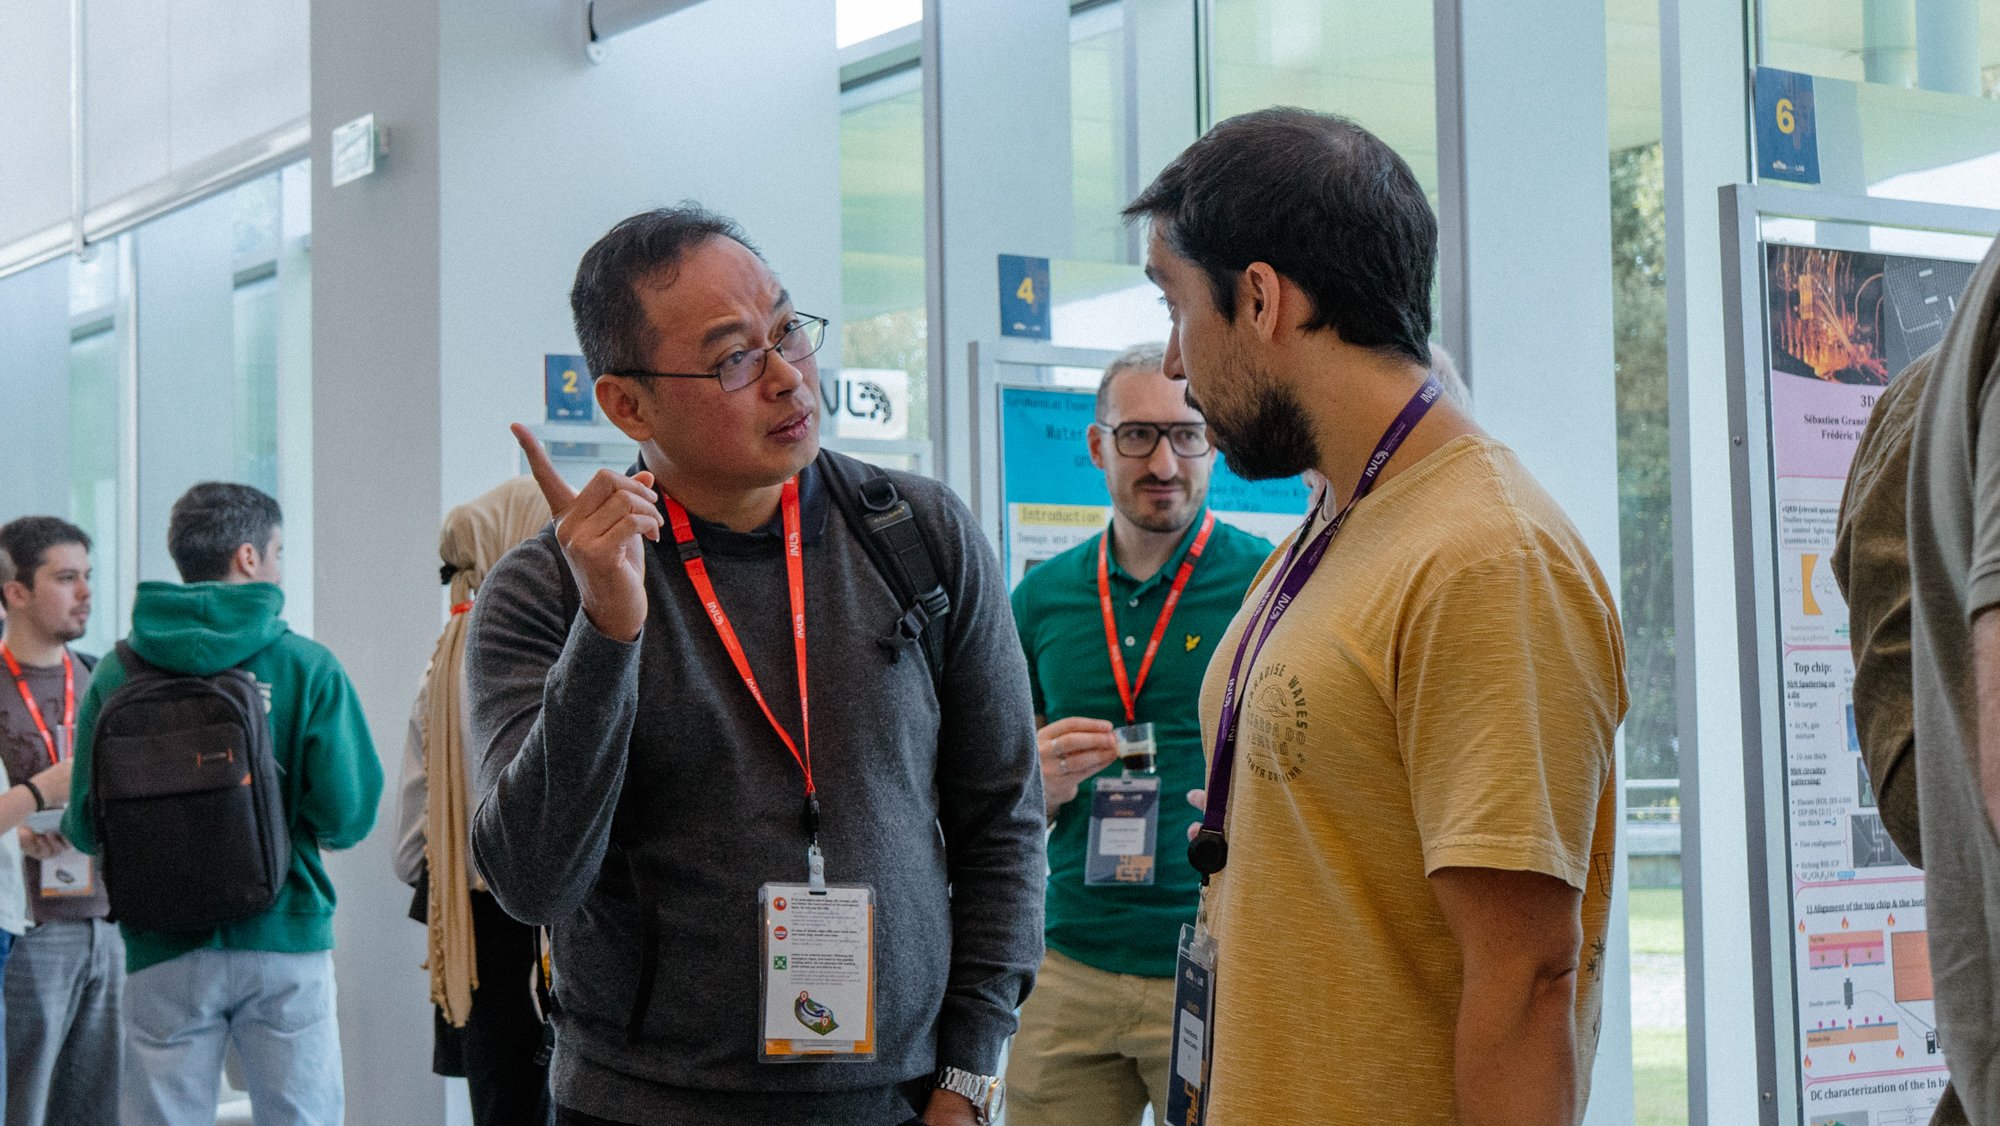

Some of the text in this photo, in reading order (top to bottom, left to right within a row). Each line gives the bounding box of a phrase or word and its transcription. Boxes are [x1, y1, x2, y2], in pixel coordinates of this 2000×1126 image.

[1776, 98, 1795, 134] 6
[1016, 277, 1035, 304] 4
[562, 370, 577, 394] 2
[1860, 395, 1875, 407] 3D
[1804, 413, 1869, 427] Sébastien Granel
[1821, 429, 1853, 441] Frédéric
[707, 602, 722, 624] INL
[1794, 662, 1832, 675] Top chip:
[1287, 675, 1308, 730] WAVES
[1814, 904, 1845, 914] Alignment
[1864, 902, 1875, 911] top
[1877, 900, 1891, 910] chip
[1899, 898, 1910, 907] the
[1810, 1090, 1823, 1101] DC
[1824, 1081, 1897, 1099] characterization
[1898, 1079, 1909, 1091] of
[1910, 1078, 1925, 1089] the
